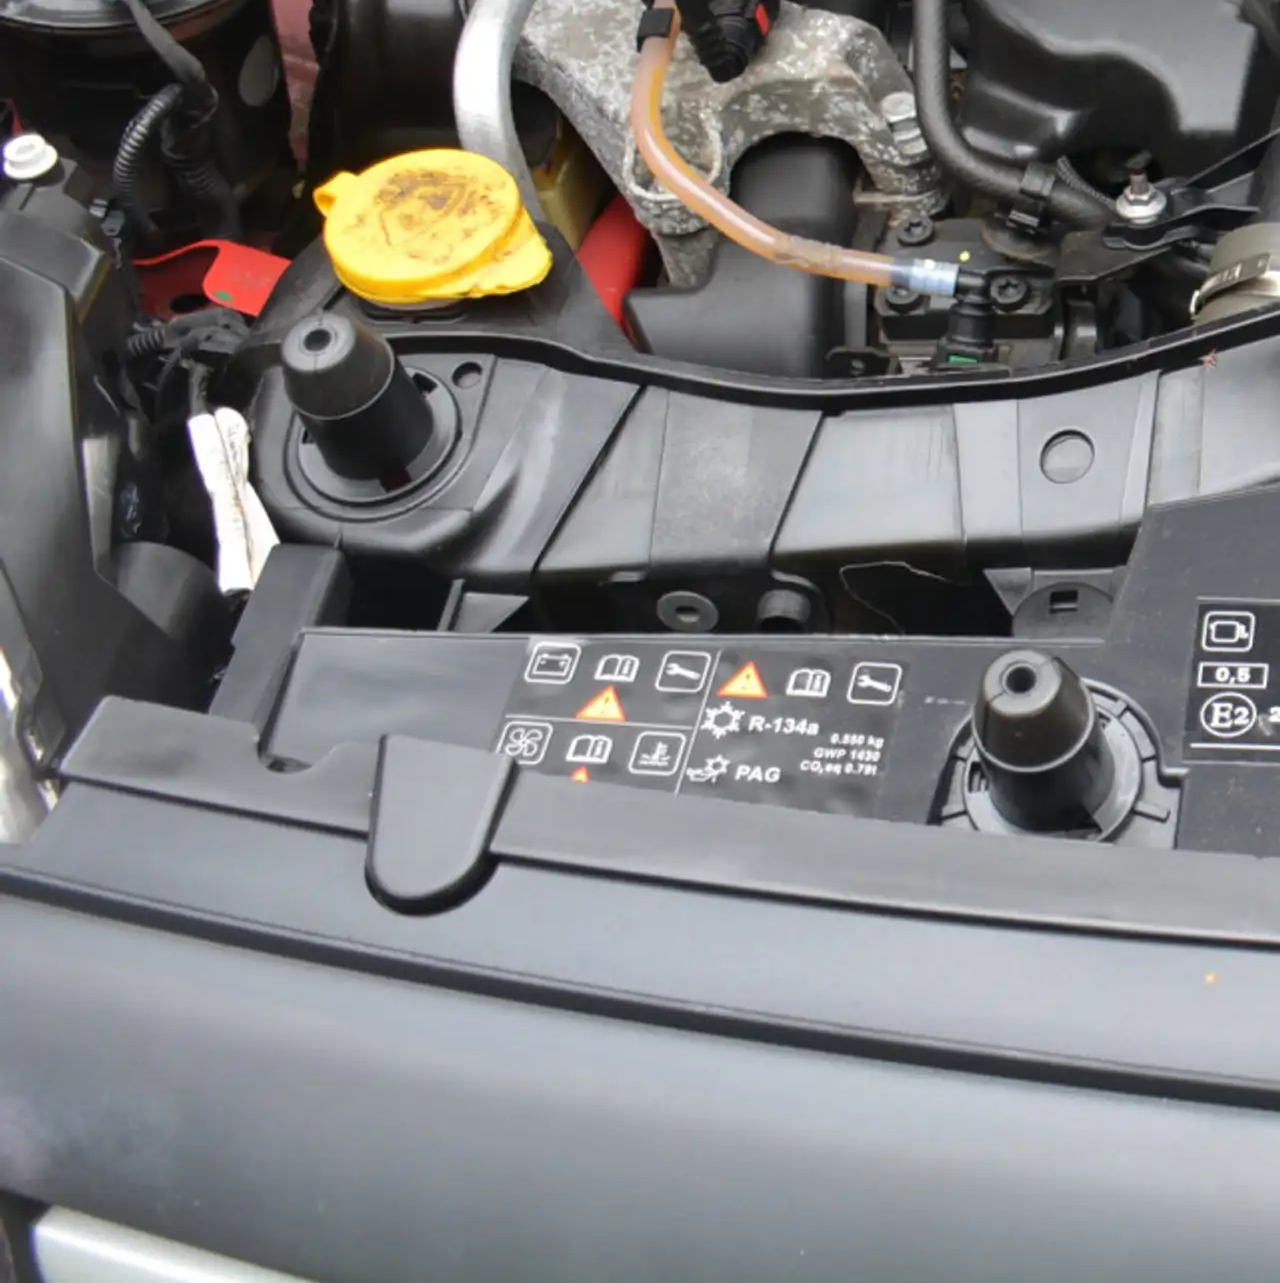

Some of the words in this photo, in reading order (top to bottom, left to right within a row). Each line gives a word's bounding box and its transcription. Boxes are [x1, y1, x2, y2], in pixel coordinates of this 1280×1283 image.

[1215, 667, 1250, 684] 0,5
[1210, 701, 1250, 729] E2
[749, 716, 819, 735] R-134a
[868, 736, 884, 748] kg
[814, 748, 846, 758] GWP
[735, 765, 781, 782] PAG
